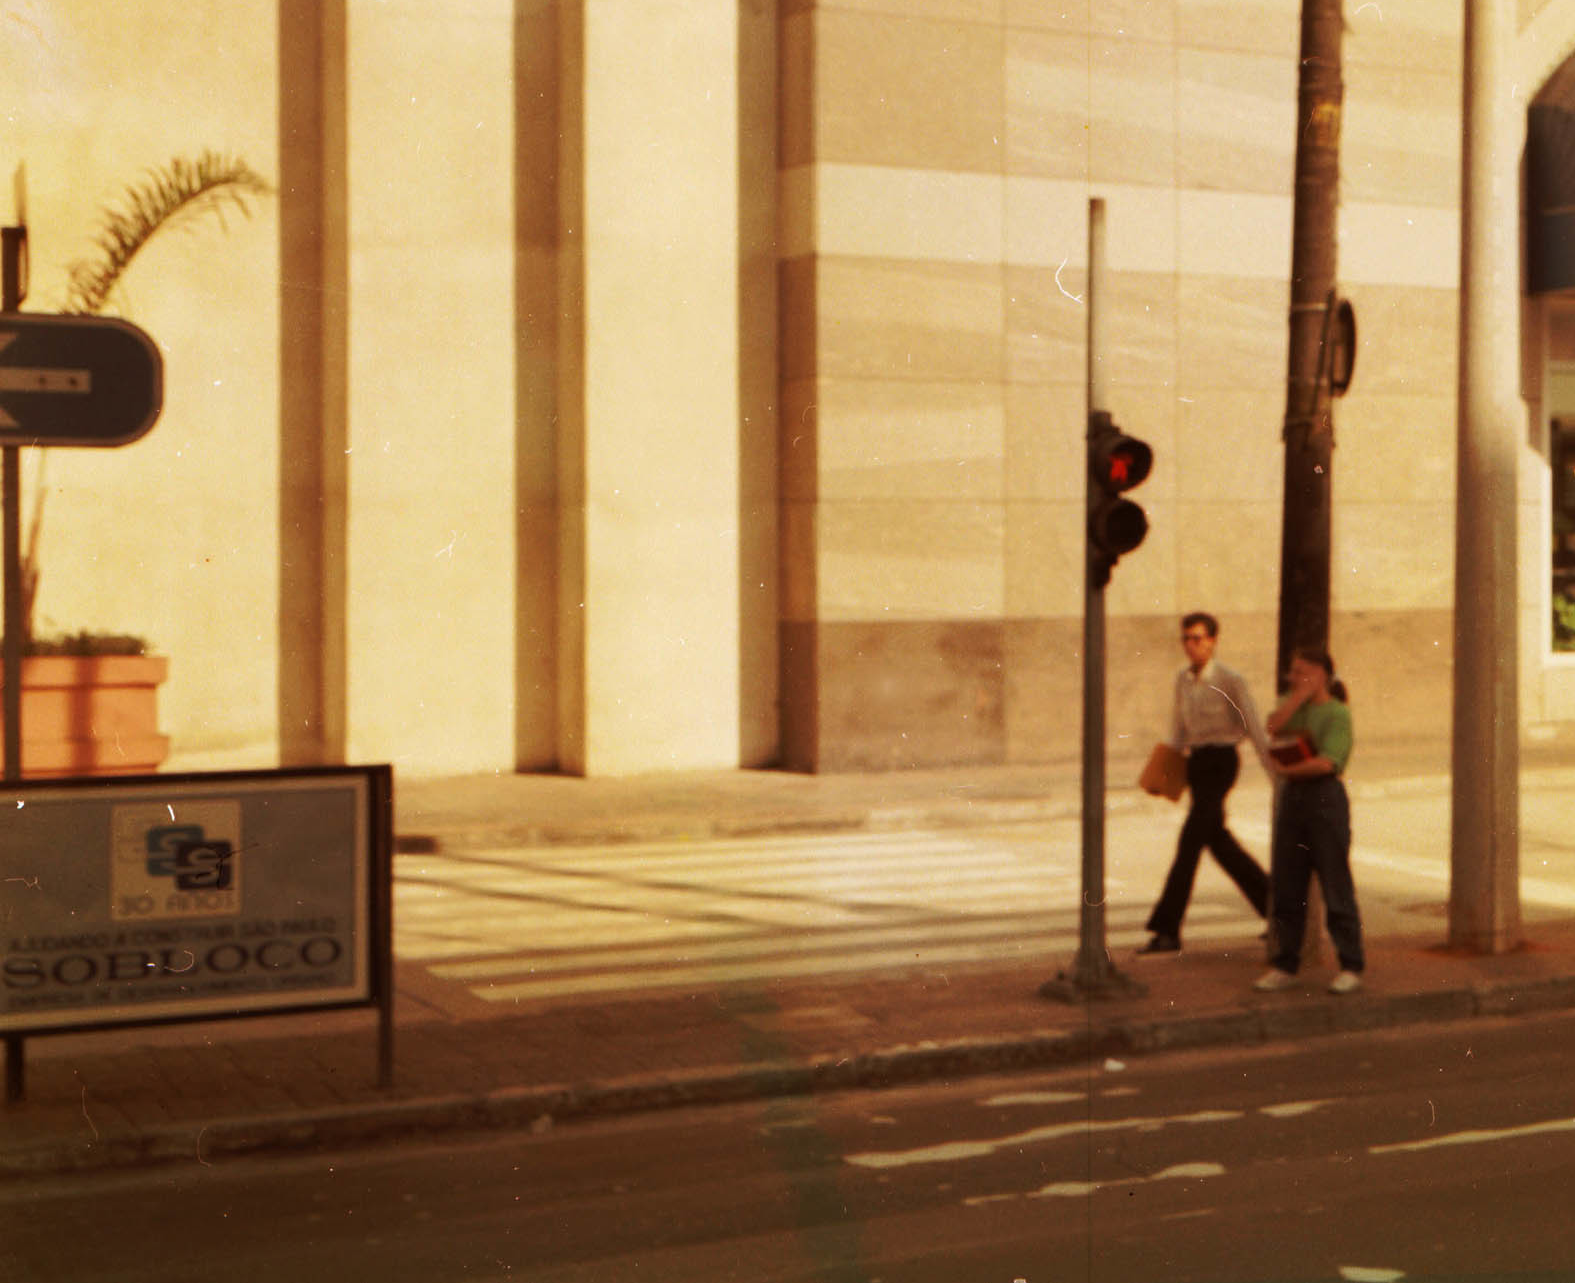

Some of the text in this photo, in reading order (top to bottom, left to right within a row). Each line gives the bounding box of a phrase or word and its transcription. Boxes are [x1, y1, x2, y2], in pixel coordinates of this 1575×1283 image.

[118, 893, 235, 916] 30 ANOS
[2, 936, 343, 990] SOBLOCO
